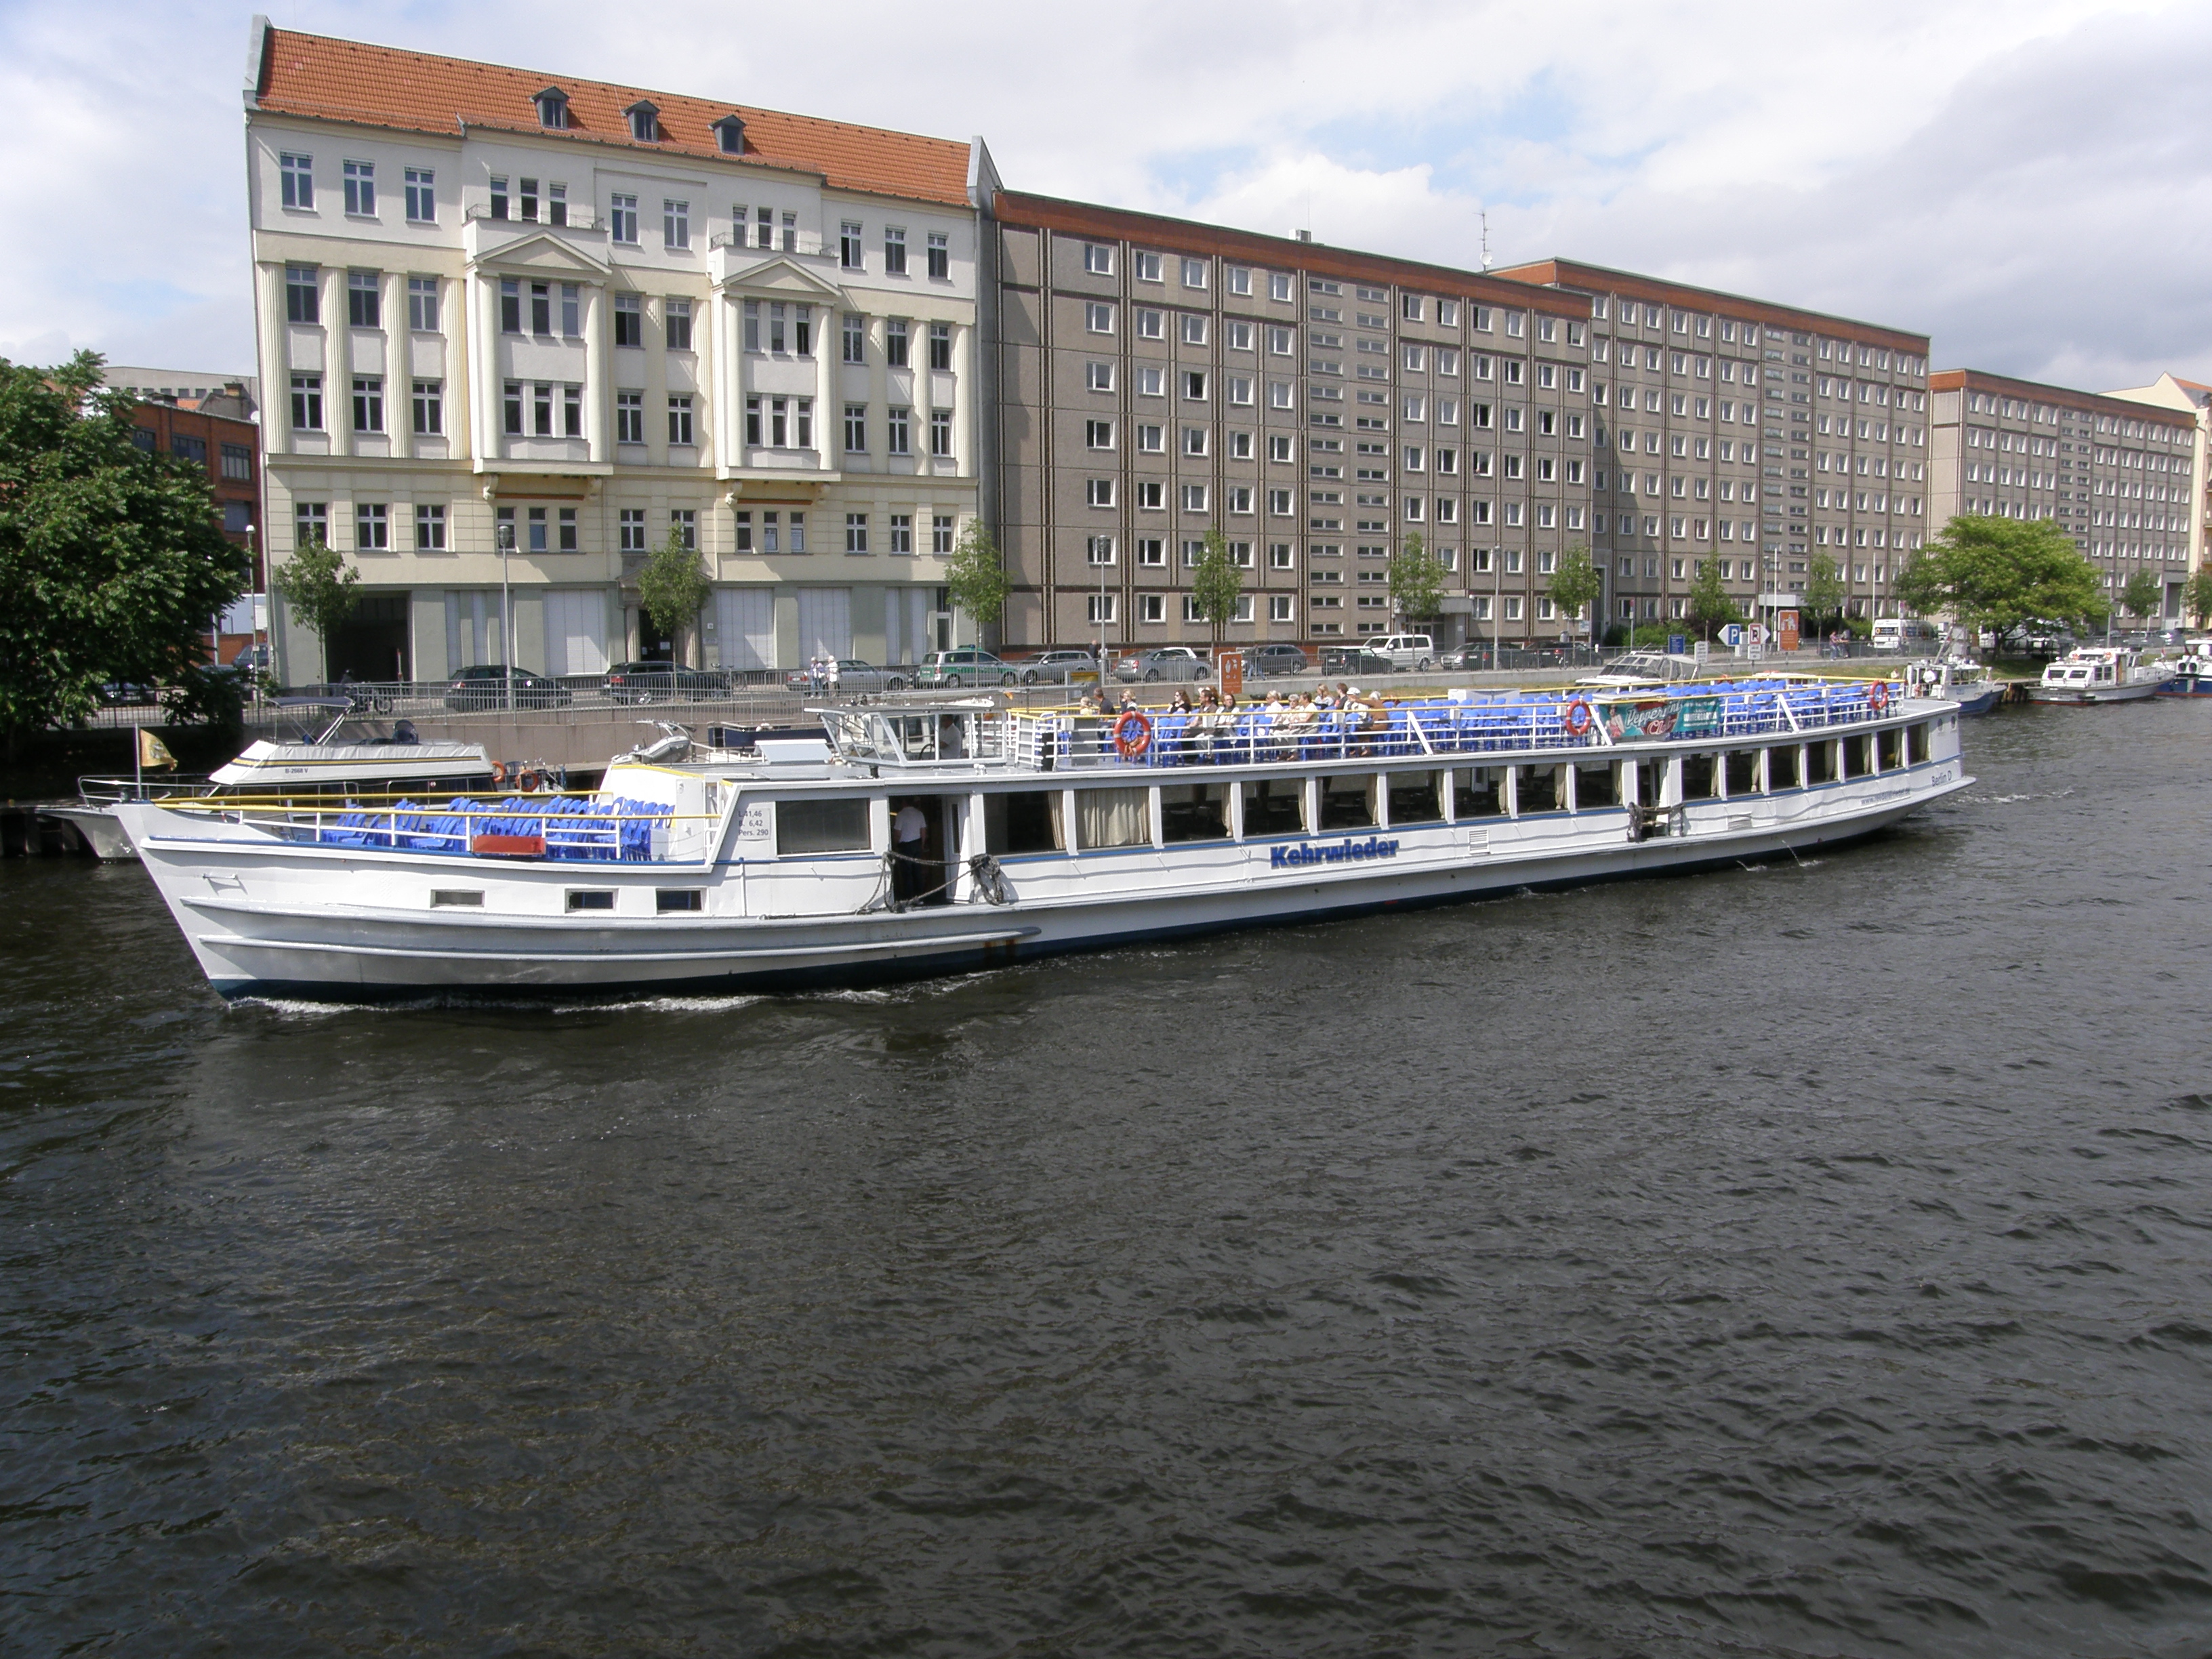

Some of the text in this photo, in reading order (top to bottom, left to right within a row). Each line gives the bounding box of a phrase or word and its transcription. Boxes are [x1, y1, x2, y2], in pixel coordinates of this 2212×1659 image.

[1731, 628, 1738, 643] P
[1931, 773, 1946, 787] Berlin
[1271, 836, 1399, 869] Kehrwieder
